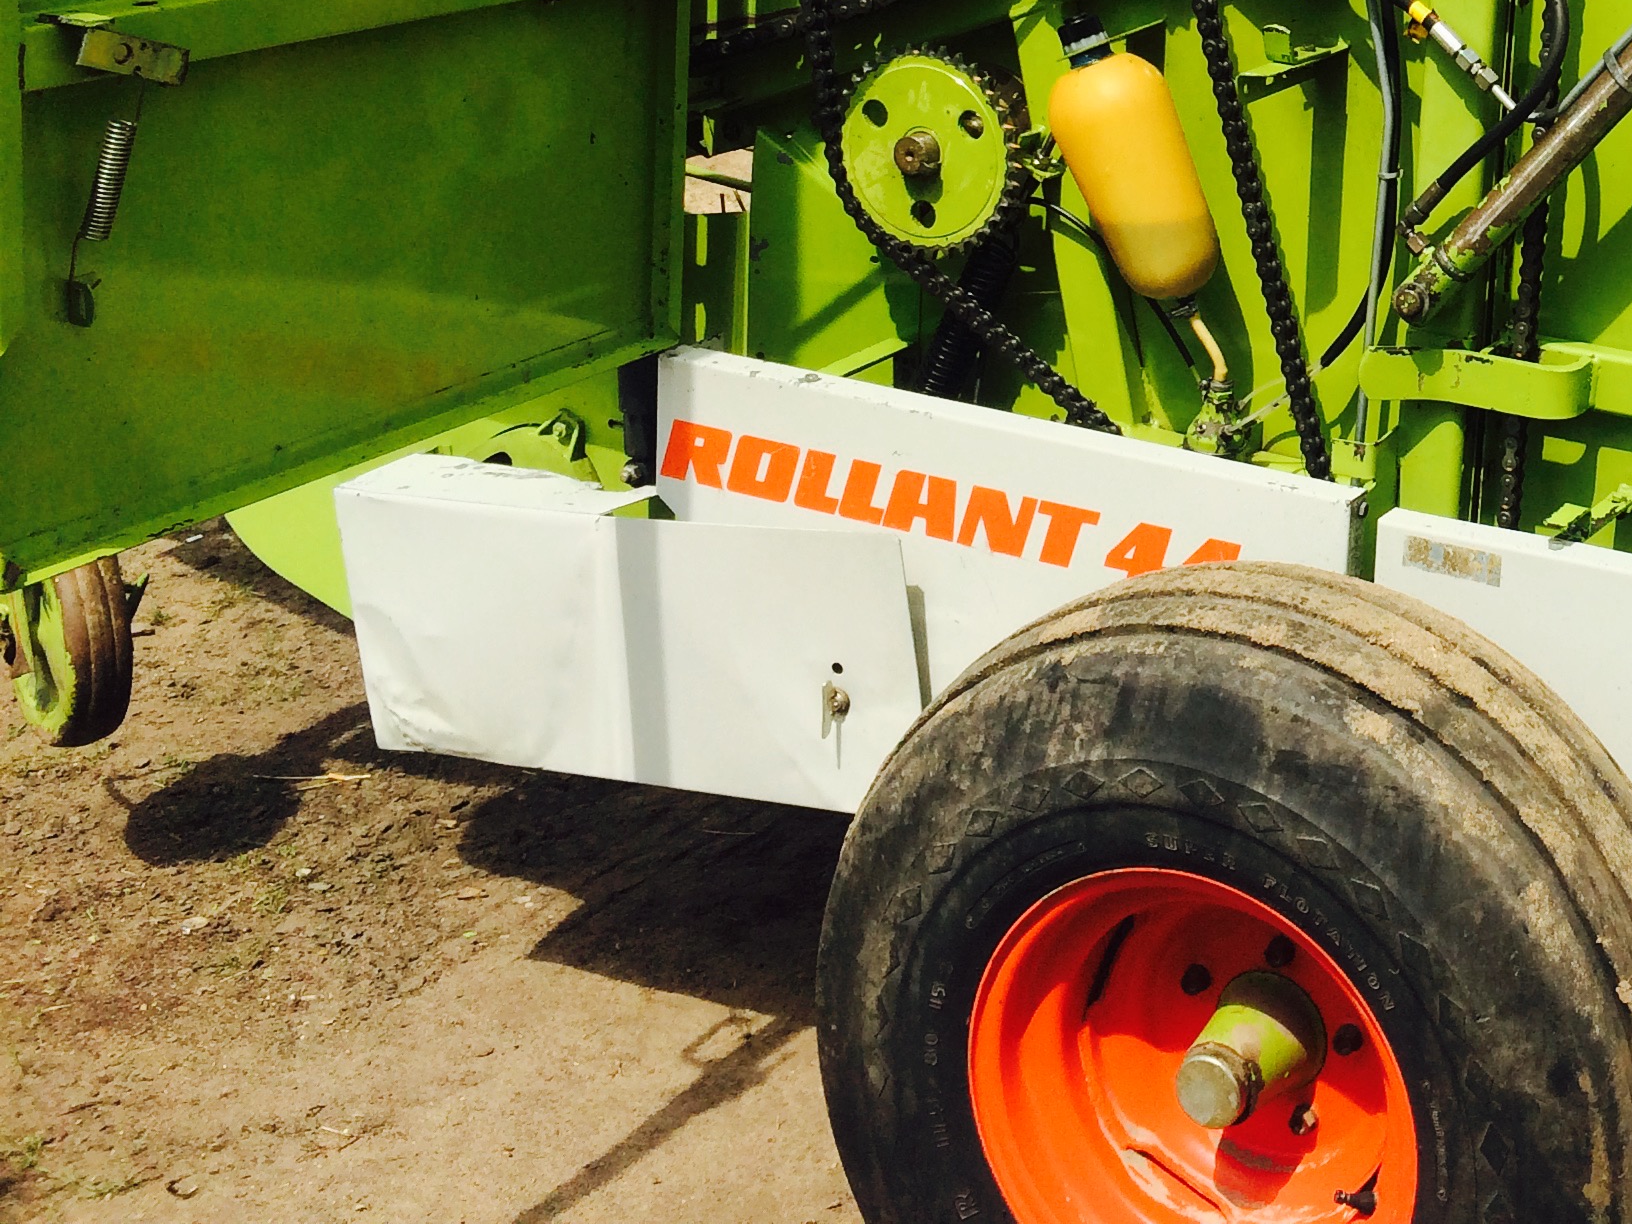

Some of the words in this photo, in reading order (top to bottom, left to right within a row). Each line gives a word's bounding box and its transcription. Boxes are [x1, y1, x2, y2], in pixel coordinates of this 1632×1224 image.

[660, 419, 1101, 568] ROLLANT
[1144, 831, 1237, 872] SUPER
[1262, 874, 1396, 1012] FLOTATION
